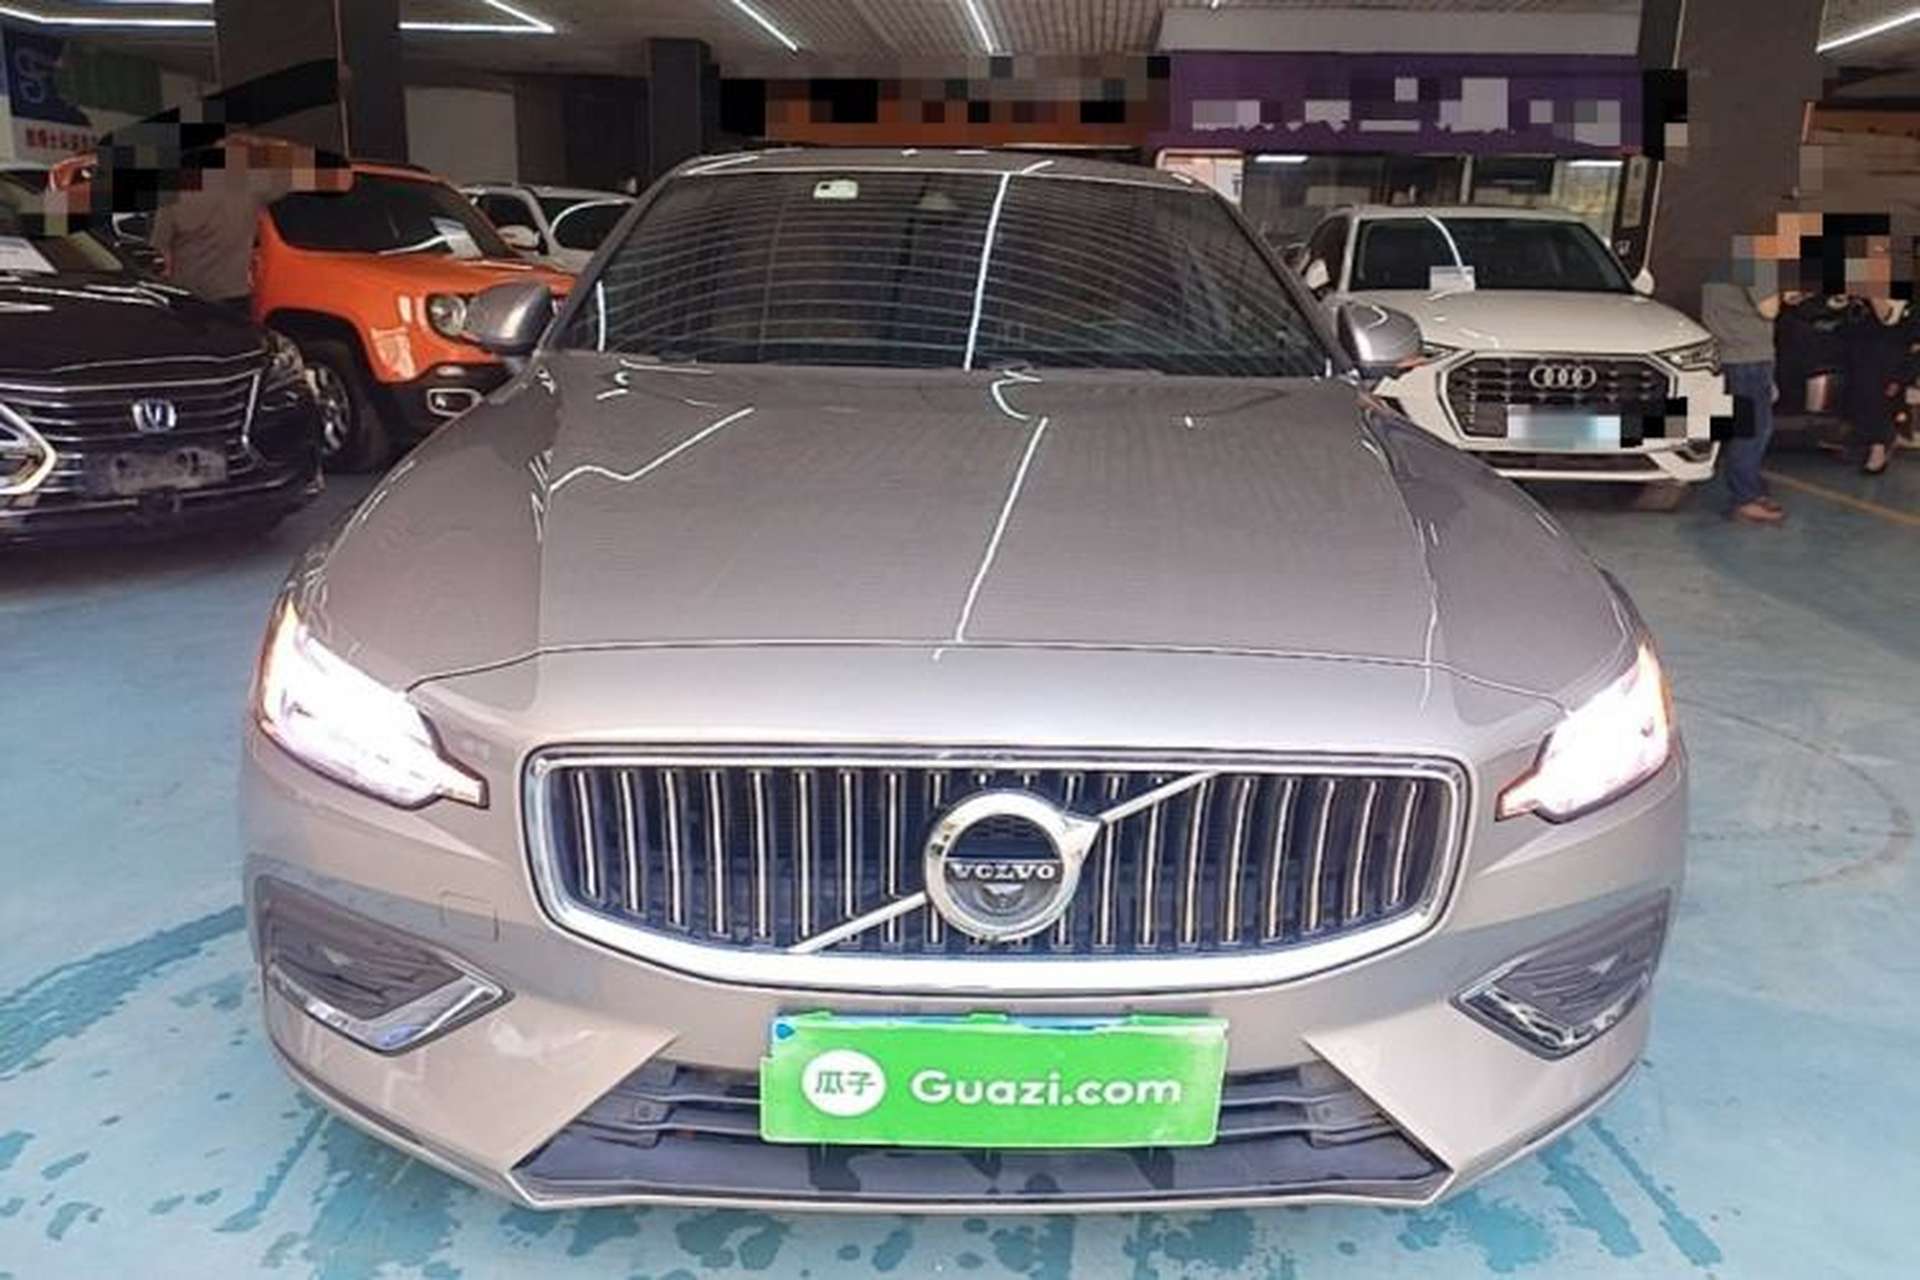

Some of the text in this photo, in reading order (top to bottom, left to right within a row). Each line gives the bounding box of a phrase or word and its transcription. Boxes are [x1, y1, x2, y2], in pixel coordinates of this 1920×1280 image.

[951, 863, 1055, 879] VOLVO
[815, 1071, 876, 1096] 瓜子
[911, 1070, 1182, 1106] Guazi.com
